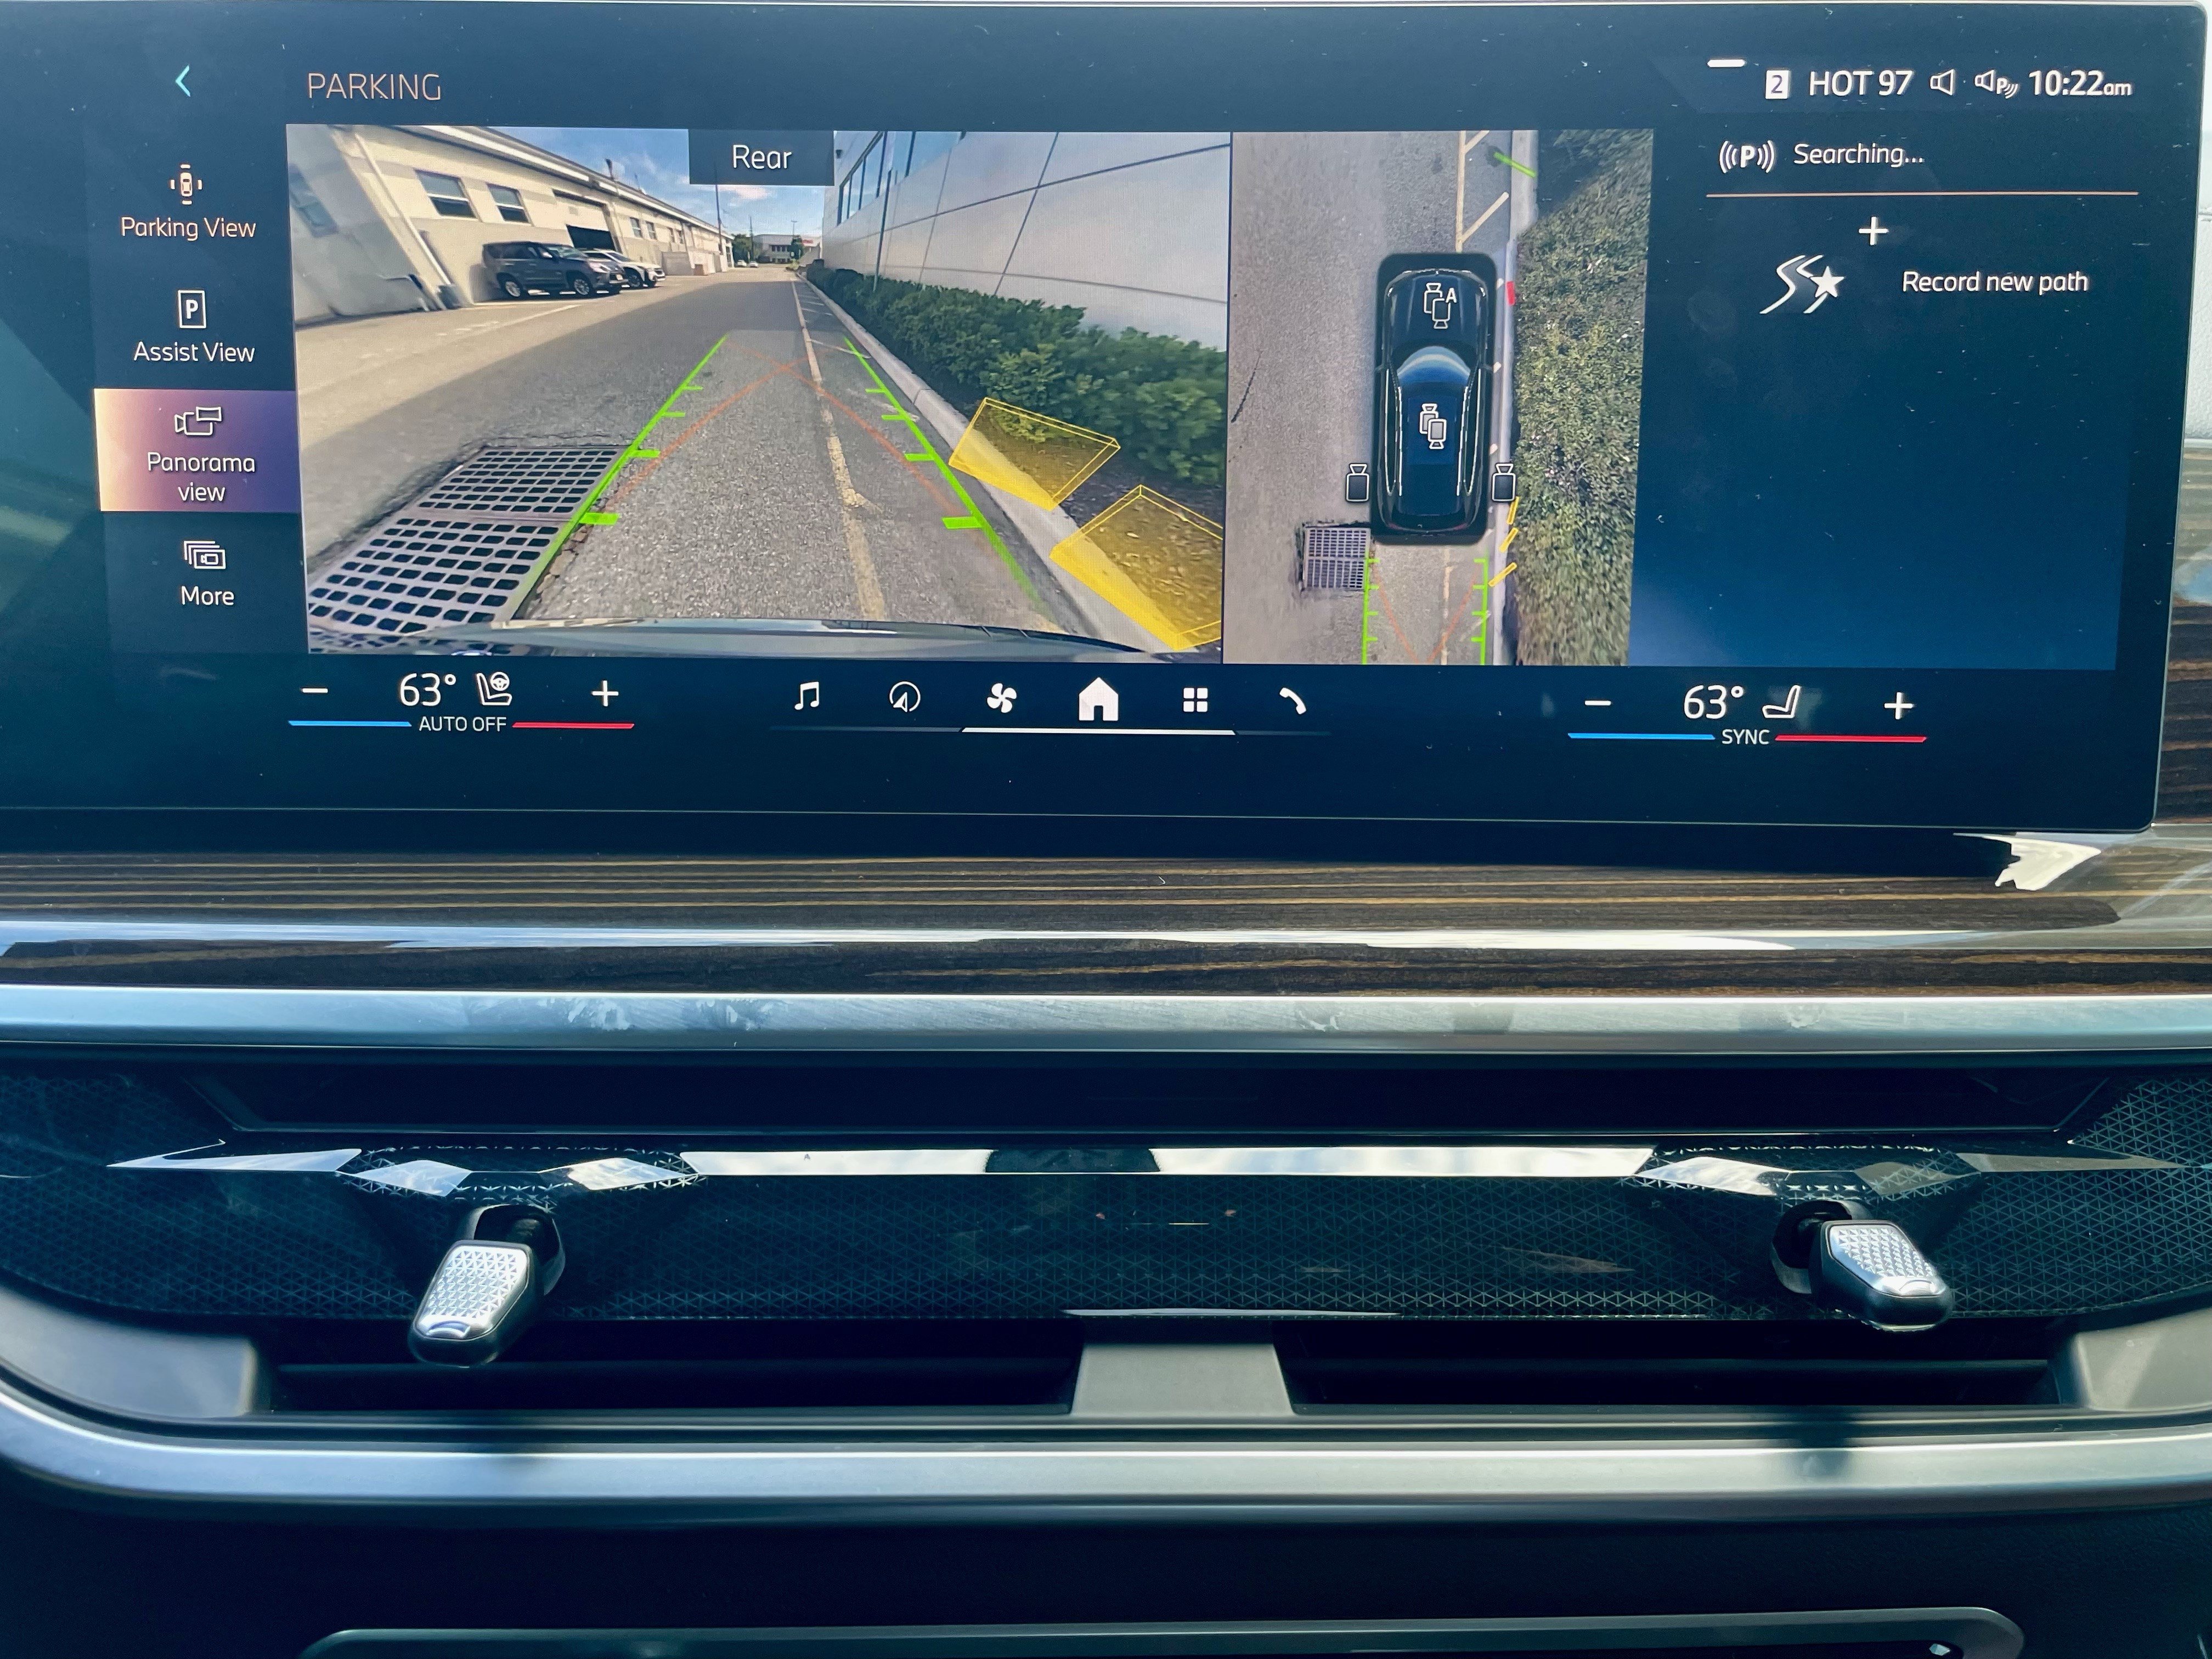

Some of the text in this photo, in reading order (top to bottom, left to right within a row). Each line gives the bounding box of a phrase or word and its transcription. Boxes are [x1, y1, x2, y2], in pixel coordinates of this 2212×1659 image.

[307, 73, 441, 100] PARKING
[1809, 70, 1913, 95] HOT 97
[732, 144, 792, 170] Rear
[1794, 143, 1924, 167] Searching...
[121, 217, 256, 241] Parking View
[1902, 270, 2088, 295] Record new path
[133, 341, 255, 362] Assist View
[147, 452, 256, 473] Panorama
[178, 482, 225, 501] view
[181, 586, 234, 606] More
[399, 673, 456, 707] 63°
[1683, 685, 1745, 719] 63°
[419, 716, 507, 732] AUTO OFF
[1722, 729, 1770, 745] SYNC
